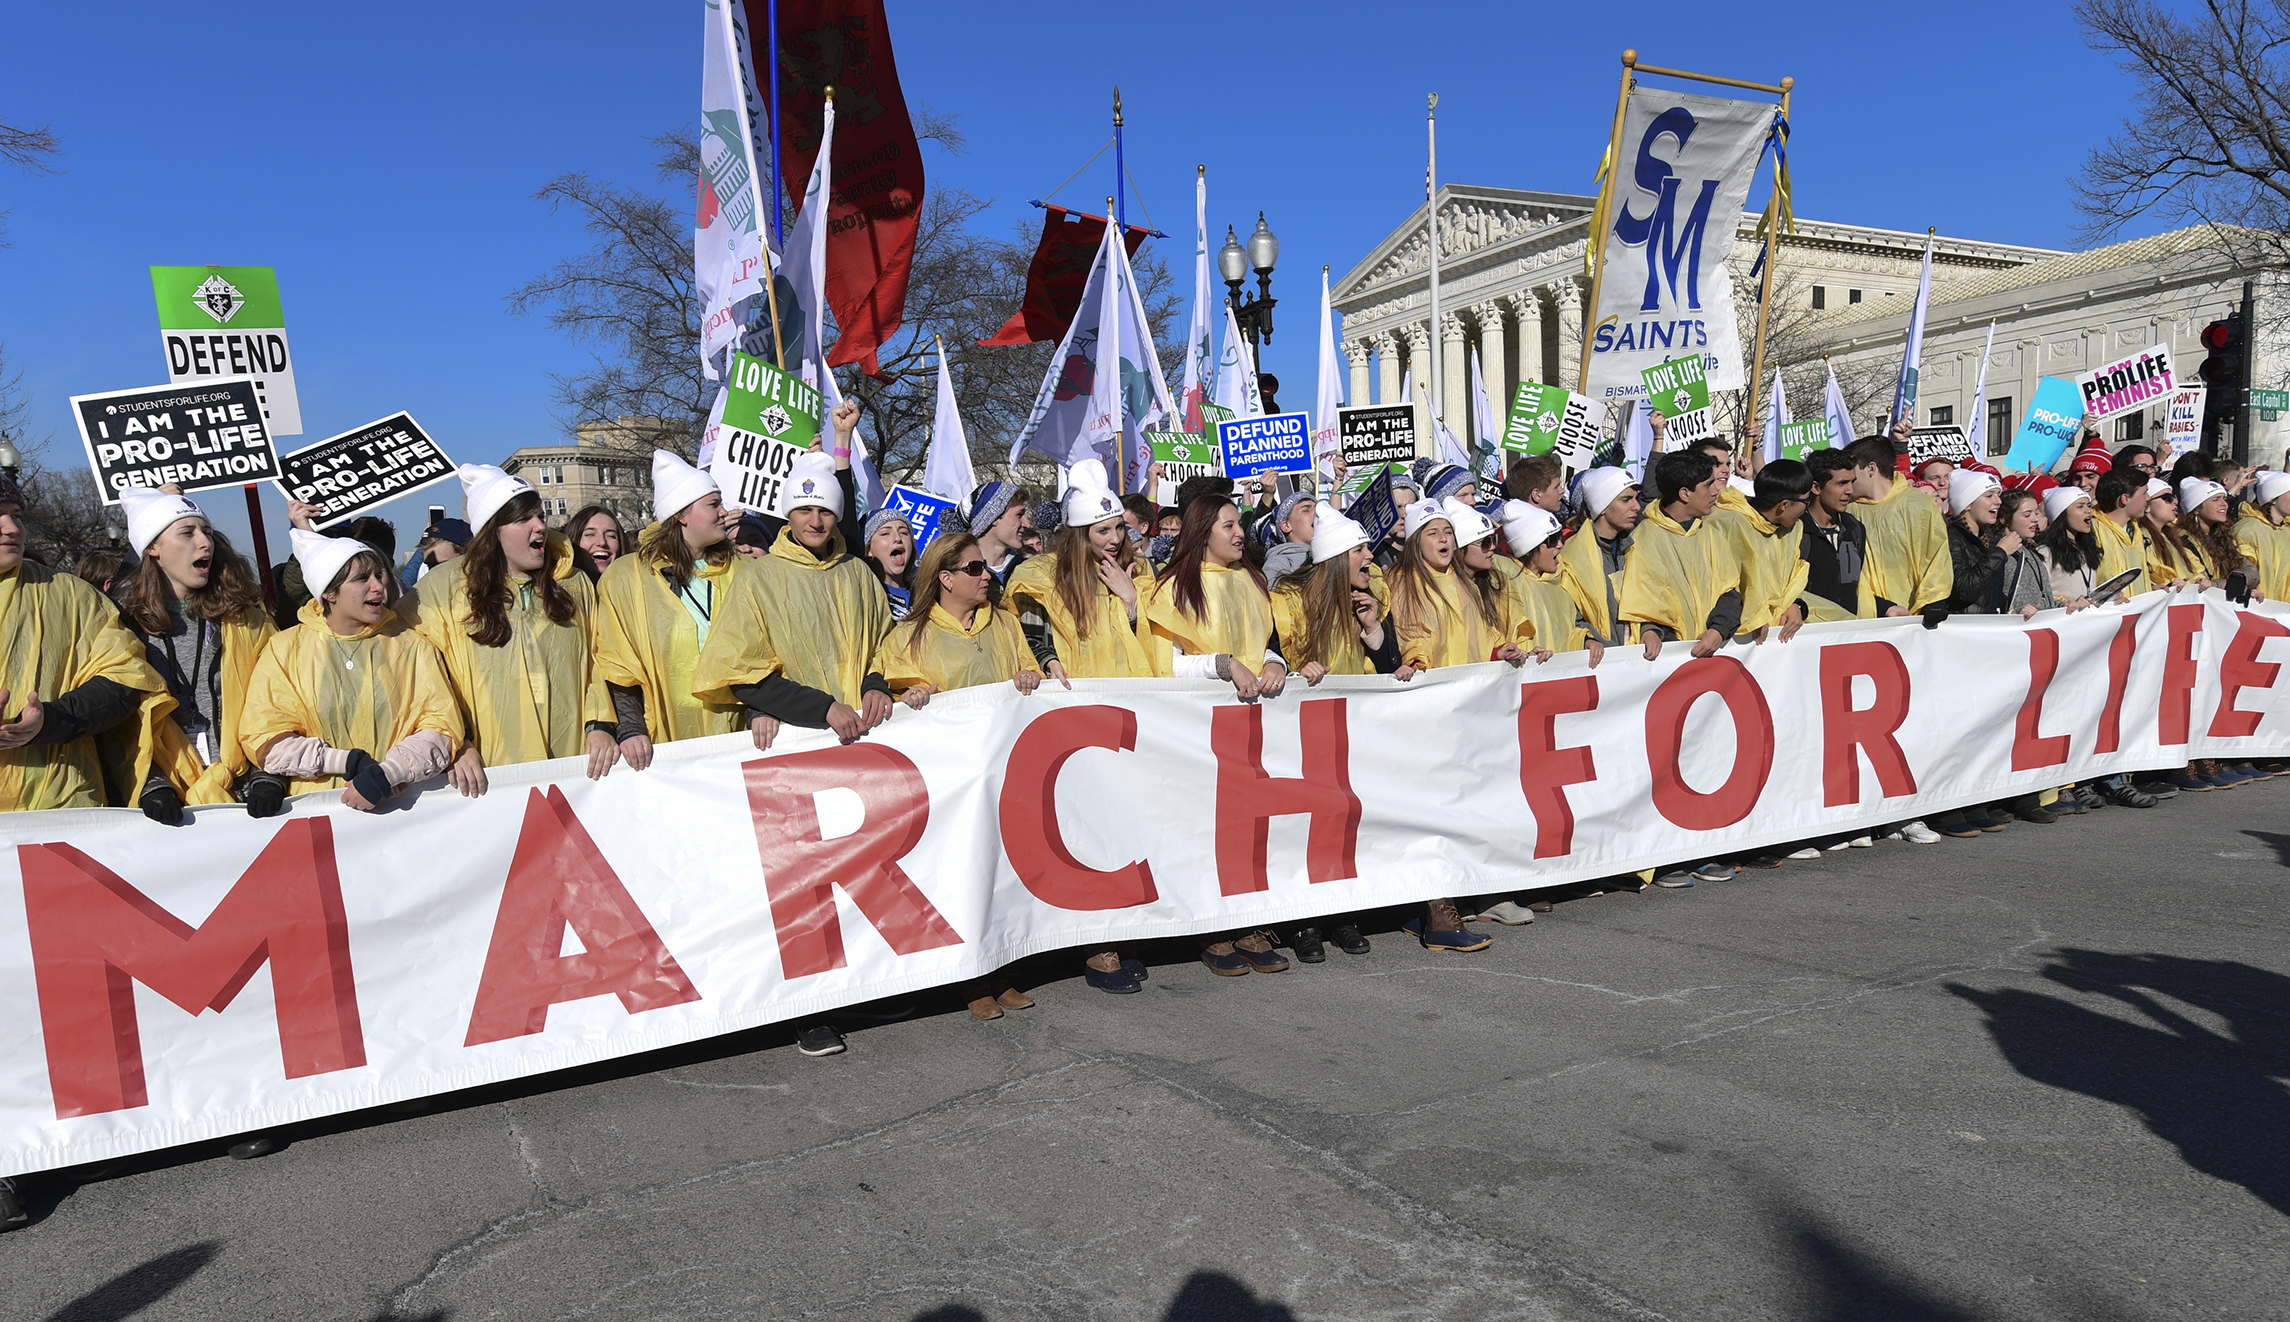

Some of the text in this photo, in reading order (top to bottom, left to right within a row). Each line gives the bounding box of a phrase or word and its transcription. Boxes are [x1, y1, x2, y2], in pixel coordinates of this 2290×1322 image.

[800, 143, 900, 193] Tadition
[1593, 319, 1708, 353] SAINTS
[167, 334, 287, 375] DEFEND
[1703, 353, 1719, 370] ife
[2108, 360, 2132, 374] AM
[2140, 353, 2150, 362] A
[735, 358, 819, 421] LOVE LIFE
[1606, 384, 1648, 397] BISMAR
[1646, 358, 1704, 395] LOVE LIFE
[2082, 353, 2169, 401] PROLIFE
[2086, 370, 2172, 416] FEMINIST
[118, 392, 231, 414] STUDENTSFORLIFE.ORG
[1200, 405, 1220, 424] LOVE
[1356, 410, 1404, 420] STUDENTSFORLIFE.ORG
[2172, 407, 2194, 420] KILL
[2250, 392, 2260, 406] East
[2262, 392, 2280, 408] Capitol
[2264, 410, 2274, 420] 100
[98, 403, 248, 438] I AM THE
[1226, 418, 1302, 442] DEFUND
[1346, 418, 1409, 432] I AM THE
[1504, 384, 1544, 450] LOVE LIFE
[1558, 400, 1588, 456] CHOOSE
[1666, 410, 1707, 442] CHOOSE
[2028, 421, 2076, 442] PRO-WO
[2033, 408, 2081, 430] PRO-LIFE
[96, 424, 266, 468] PRO-LIFE
[300, 426, 393, 465] STUDENTSFORLIFE.ORG
[1148, 432, 1204, 446] LOVE LIFE
[1229, 434, 1303, 456] PLANNED
[1342, 430, 1414, 450] PRO-LIFE
[1578, 422, 1600, 450] LIFE
[1782, 422, 1828, 448] LOVE LIFE
[1908, 444, 1970, 457] PLANNED
[288, 430, 413, 485] I AM THE
[728, 430, 805, 479] CHOOS
[1230, 449, 1304, 467] PARENTHOOD
[1345, 446, 1412, 463] GENERATION
[110, 452, 269, 491] GENERATION
[292, 440, 436, 503] PRO-LIFE
[314, 458, 445, 517] GENERATION
[738, 472, 781, 512] LIFE
[1374, 474, 1394, 529] DEFUND
[913, 503, 935, 540] LIFE
[1360, 490, 1381, 543] PLANNED
[17, 603, 2290, 1121] MARCH FOR LIFE
